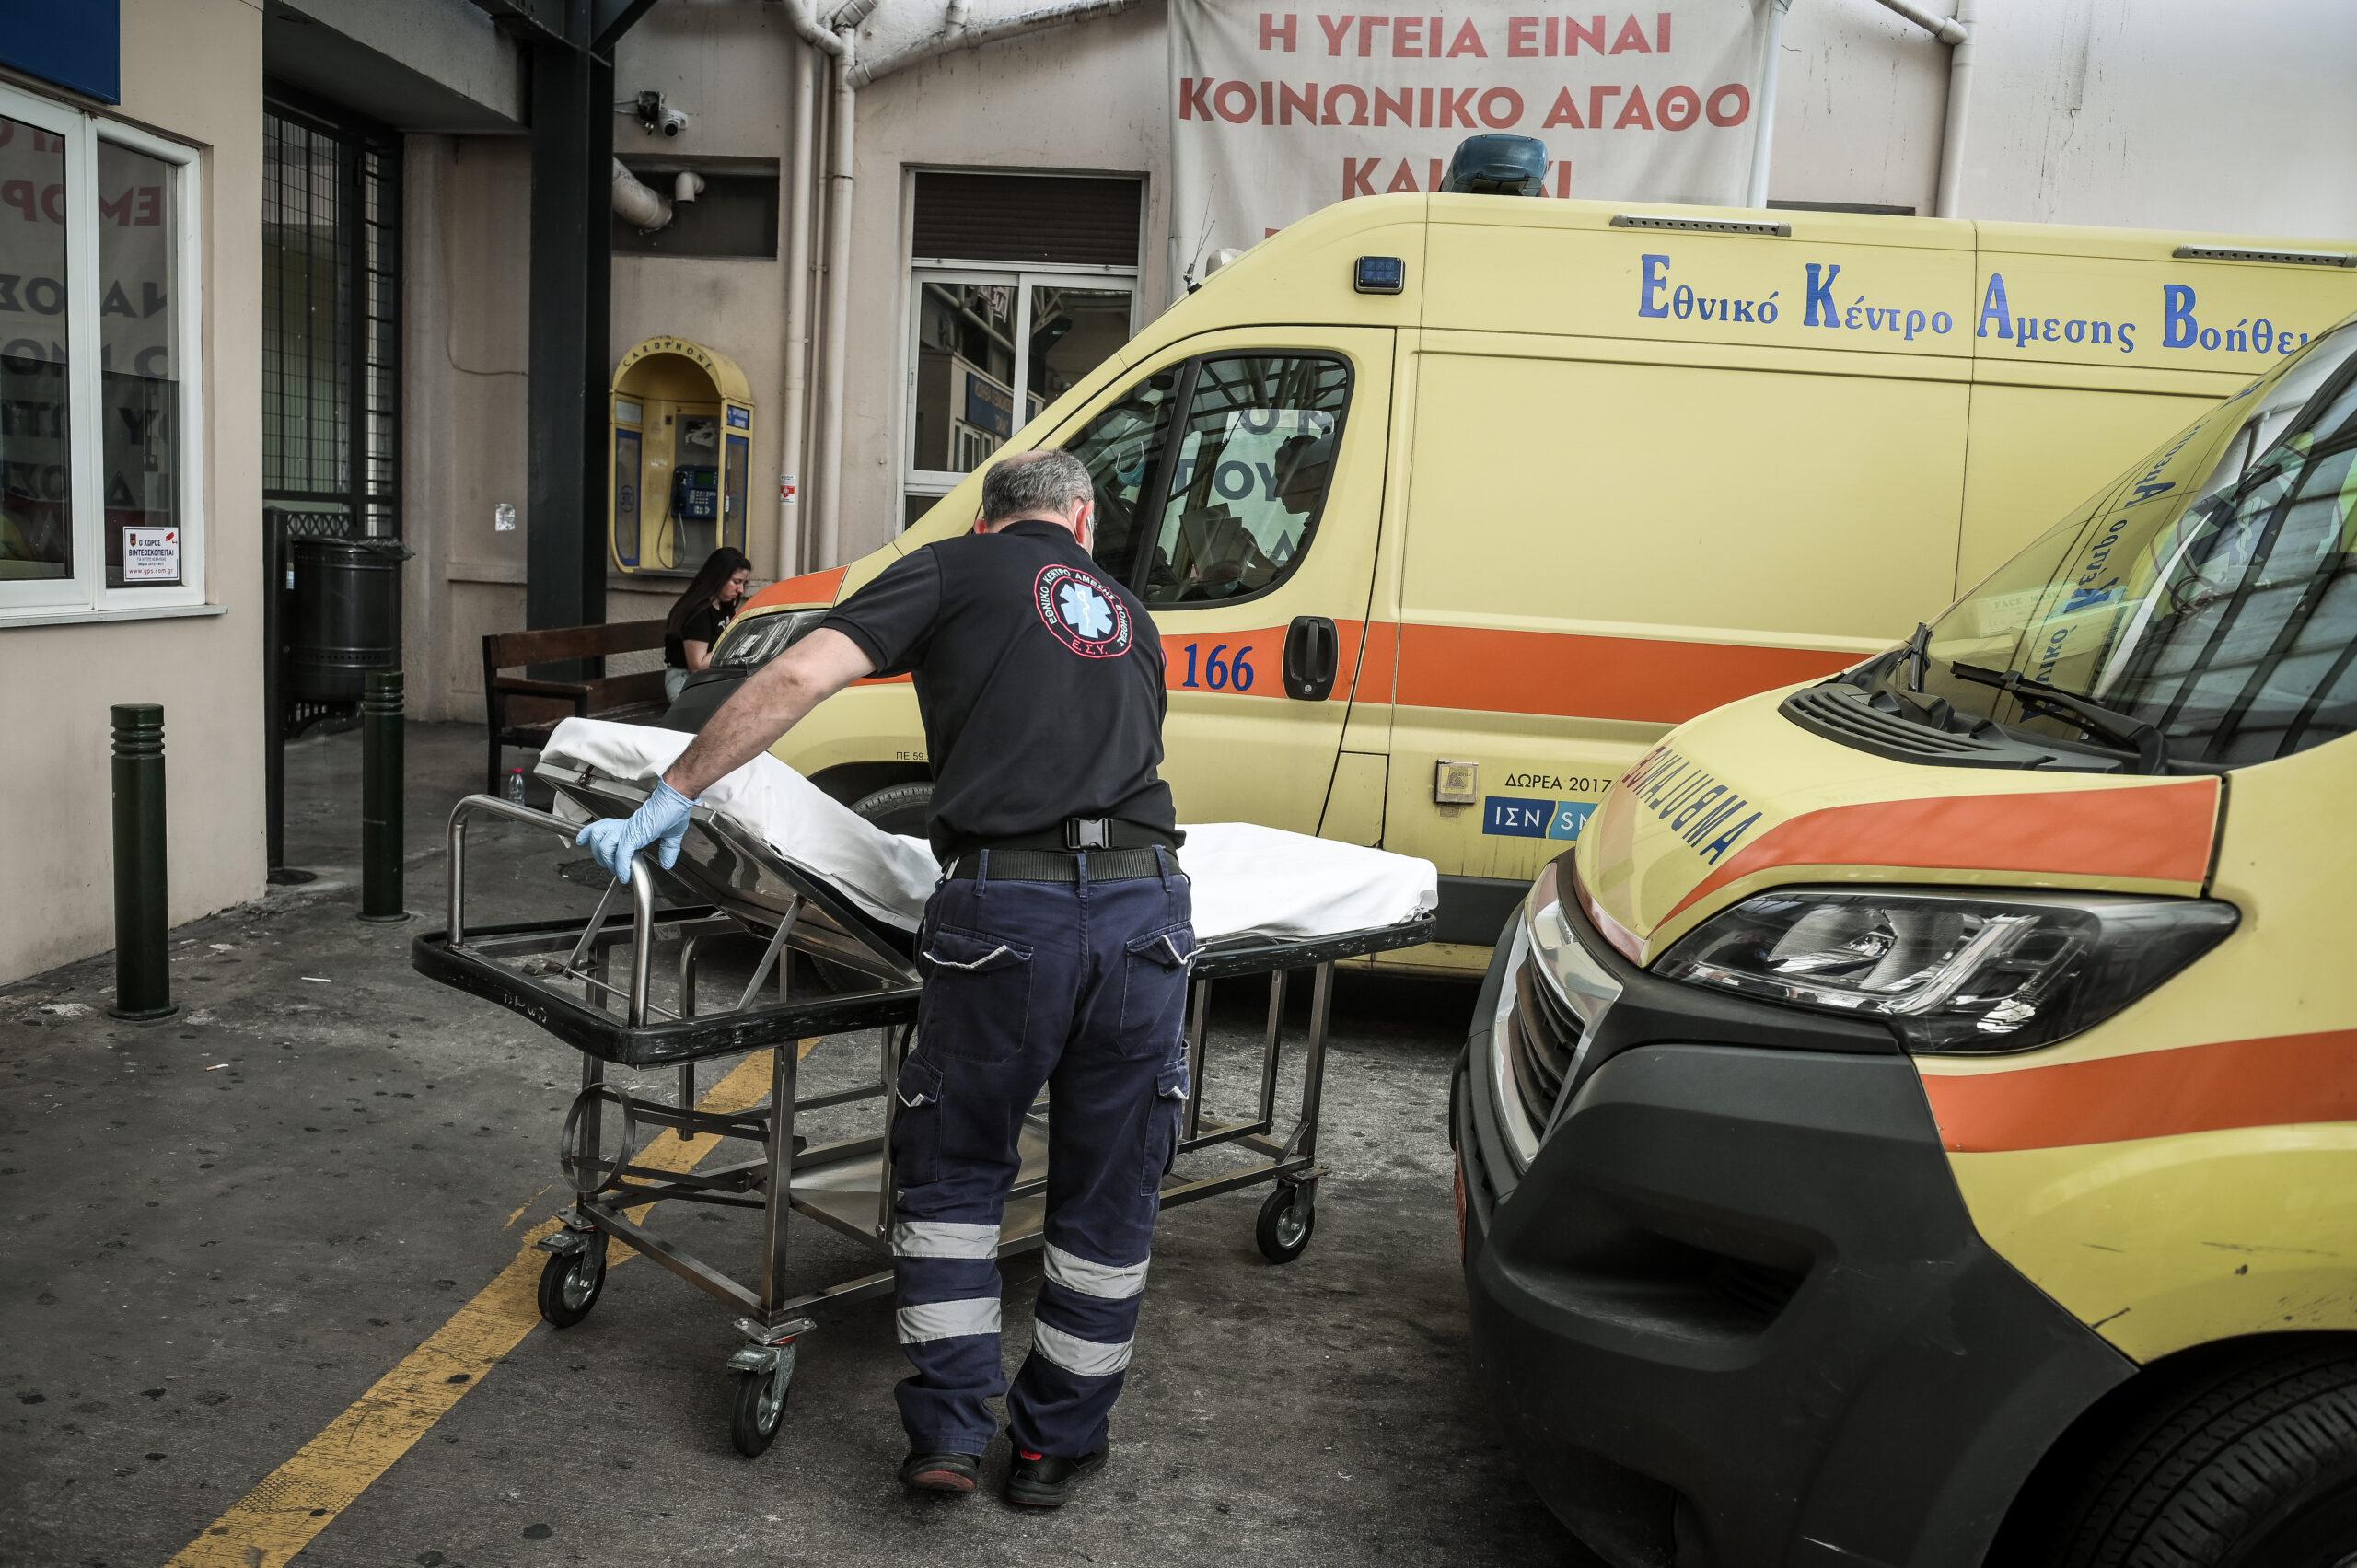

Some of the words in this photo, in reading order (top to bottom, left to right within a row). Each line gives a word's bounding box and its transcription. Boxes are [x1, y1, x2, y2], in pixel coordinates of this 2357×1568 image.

[1259, 13, 1297, 52] Η
[1316, 14, 1488, 58] ΥΓΕΙΑ
[1507, 12, 1671, 58] ΕΙΝΑΙ
[1178, 76, 1525, 130] ΚΟΙΝΩΝΙΚΟ
[1540, 82, 1751, 132] ΑΓΑΘΟ
[1341, 157, 1444, 201] ΚΑΙ
[1638, 253, 1780, 325] Εθνικό
[1803, 262, 1954, 342] Κέντρο
[1976, 273, 2137, 354] Αμεσης
[1042, 567, 1071, 586] ΚΕΝΤΡΟ
[1039, 586, 1058, 625] ΕΘΝΙΚΟ
[1181, 642, 1255, 691] 166
[912, 751, 929, 761] 59.
[1504, 773, 1562, 790] ΔΩΡΕΑ
[1569, 776, 1613, 793] 2017
[1495, 807, 1540, 828] ΙΣΝ
